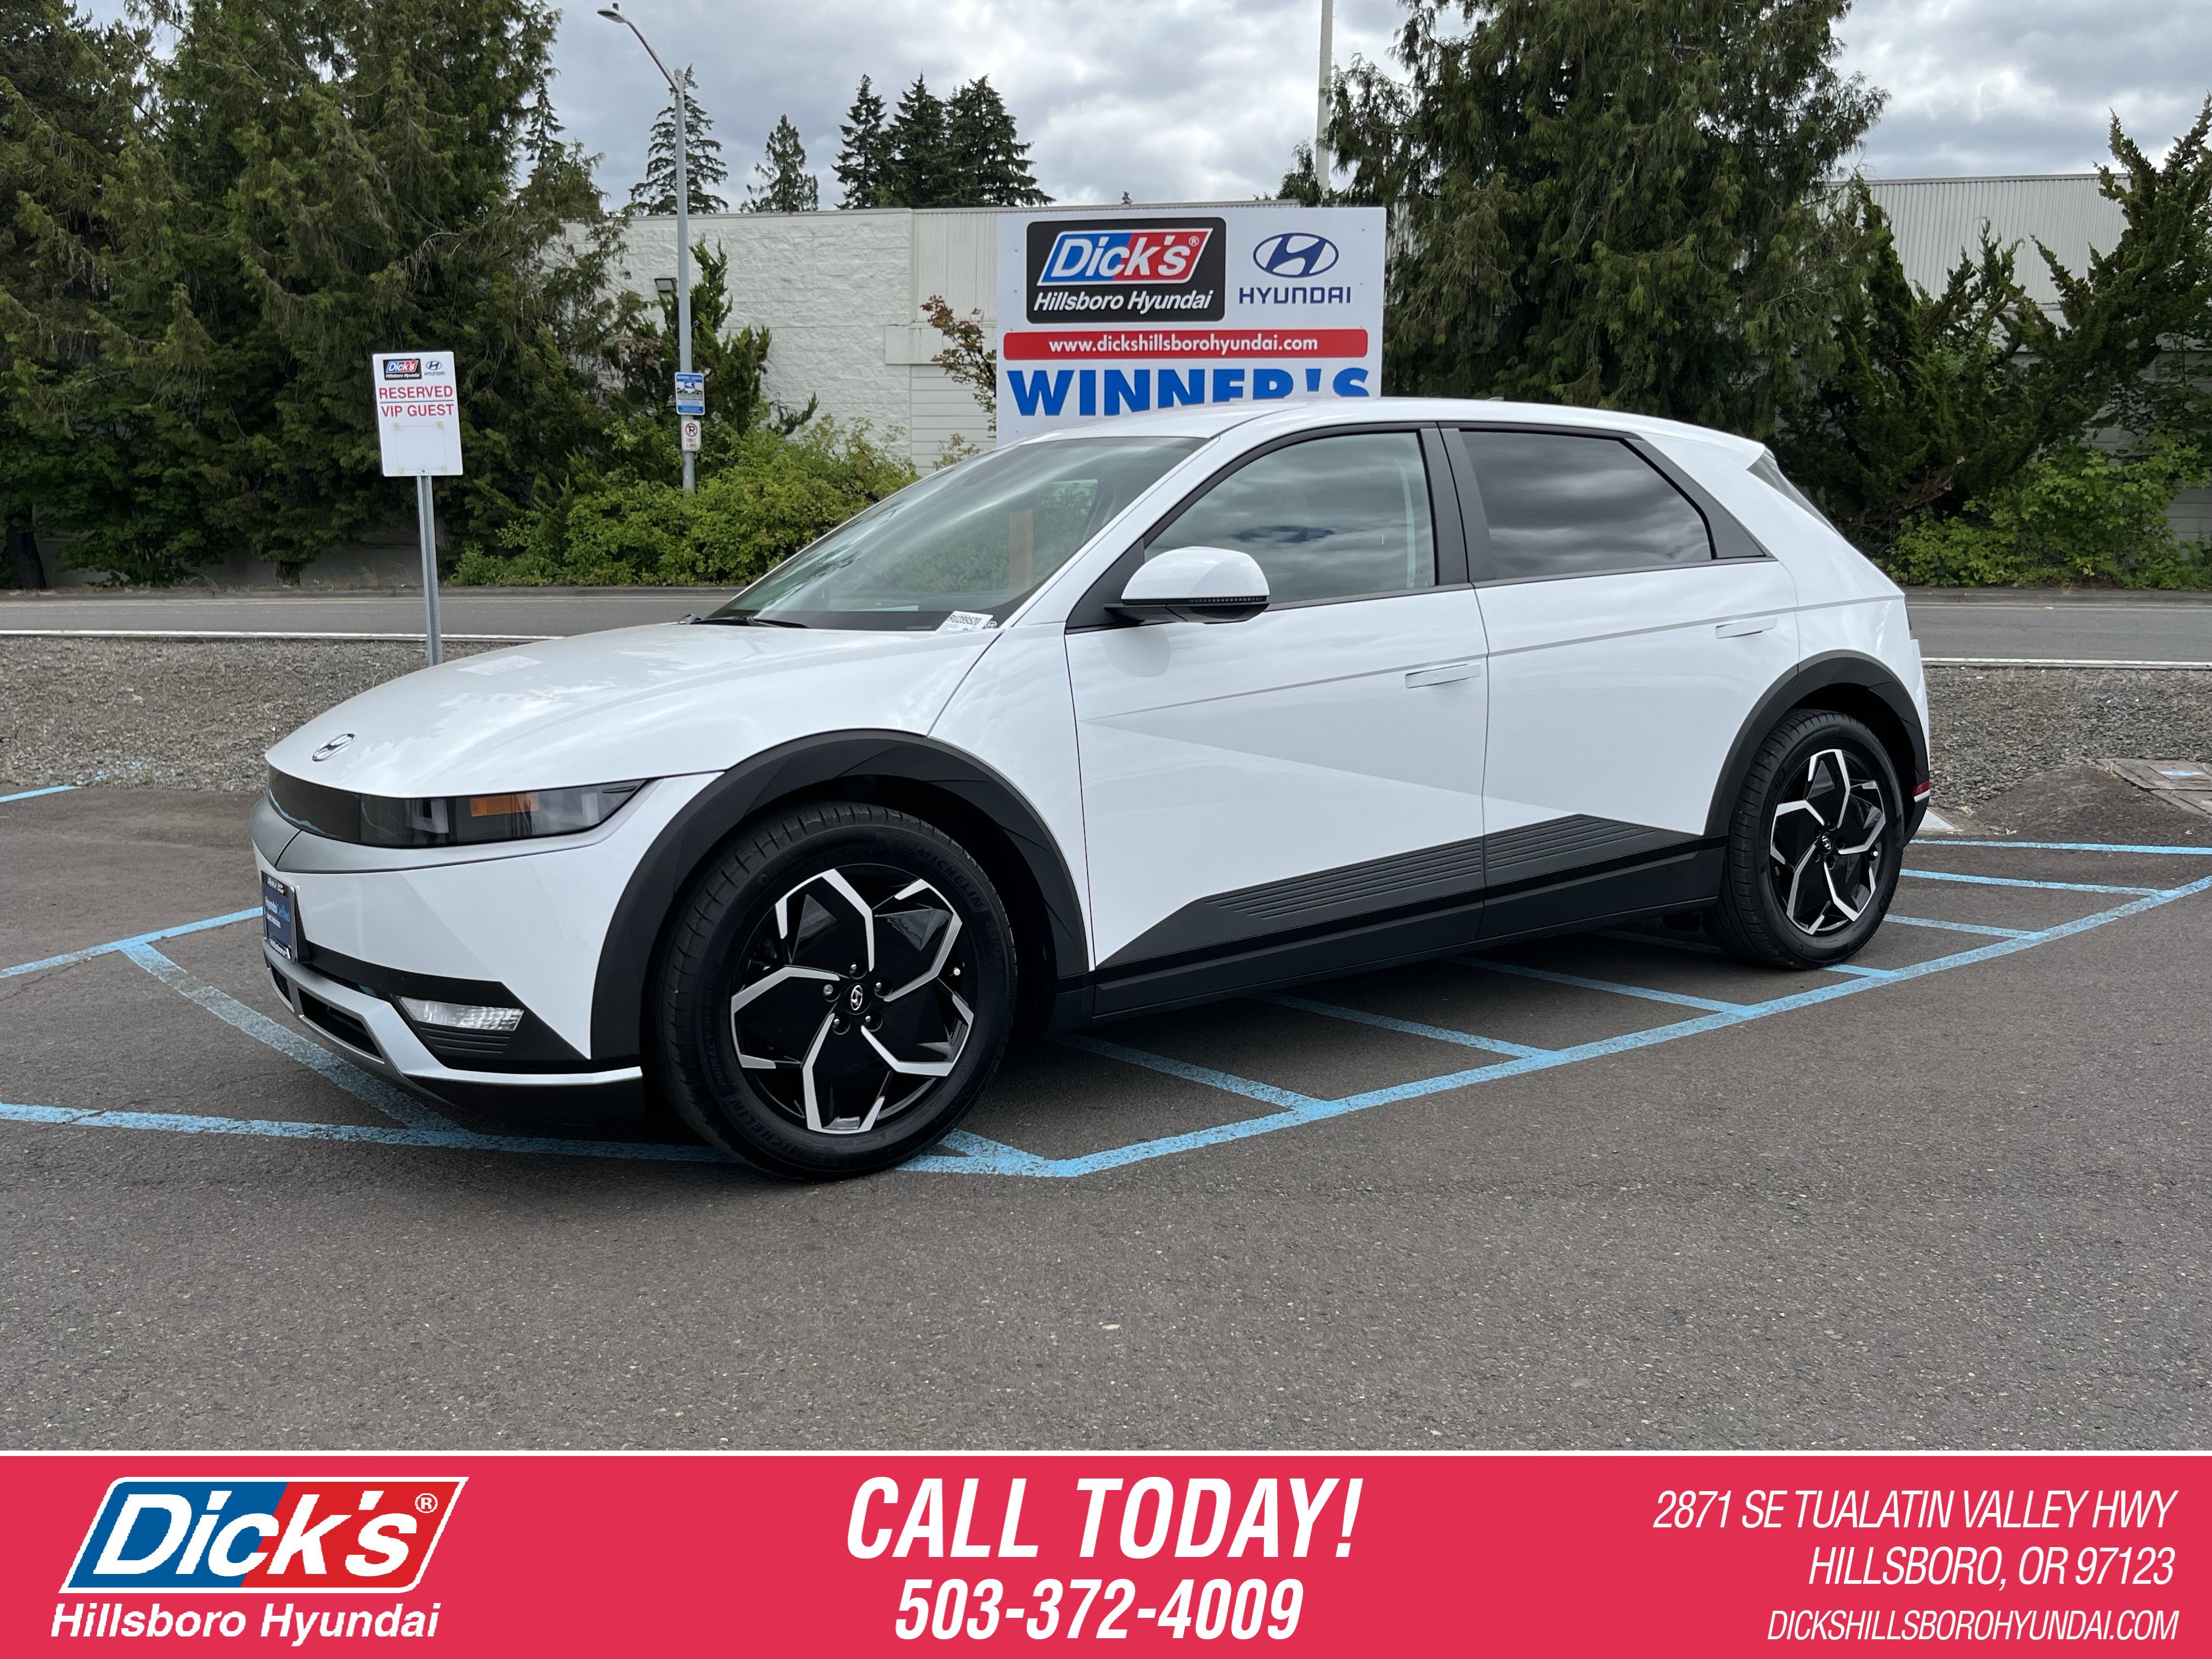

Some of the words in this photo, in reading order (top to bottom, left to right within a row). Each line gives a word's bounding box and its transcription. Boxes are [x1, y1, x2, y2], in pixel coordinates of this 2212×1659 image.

[1034, 291, 1125, 311] Hillsboro
[1127, 290, 1214, 314] Hyundai
[1239, 286, 1351, 304] HYUNDAI
[1048, 332, 1318, 356] www.dickshillsborohyundai.com
[379, 385, 453, 399] RESERVED
[381, 405, 403, 417] VIP
[407, 403, 454, 417] GUEST
